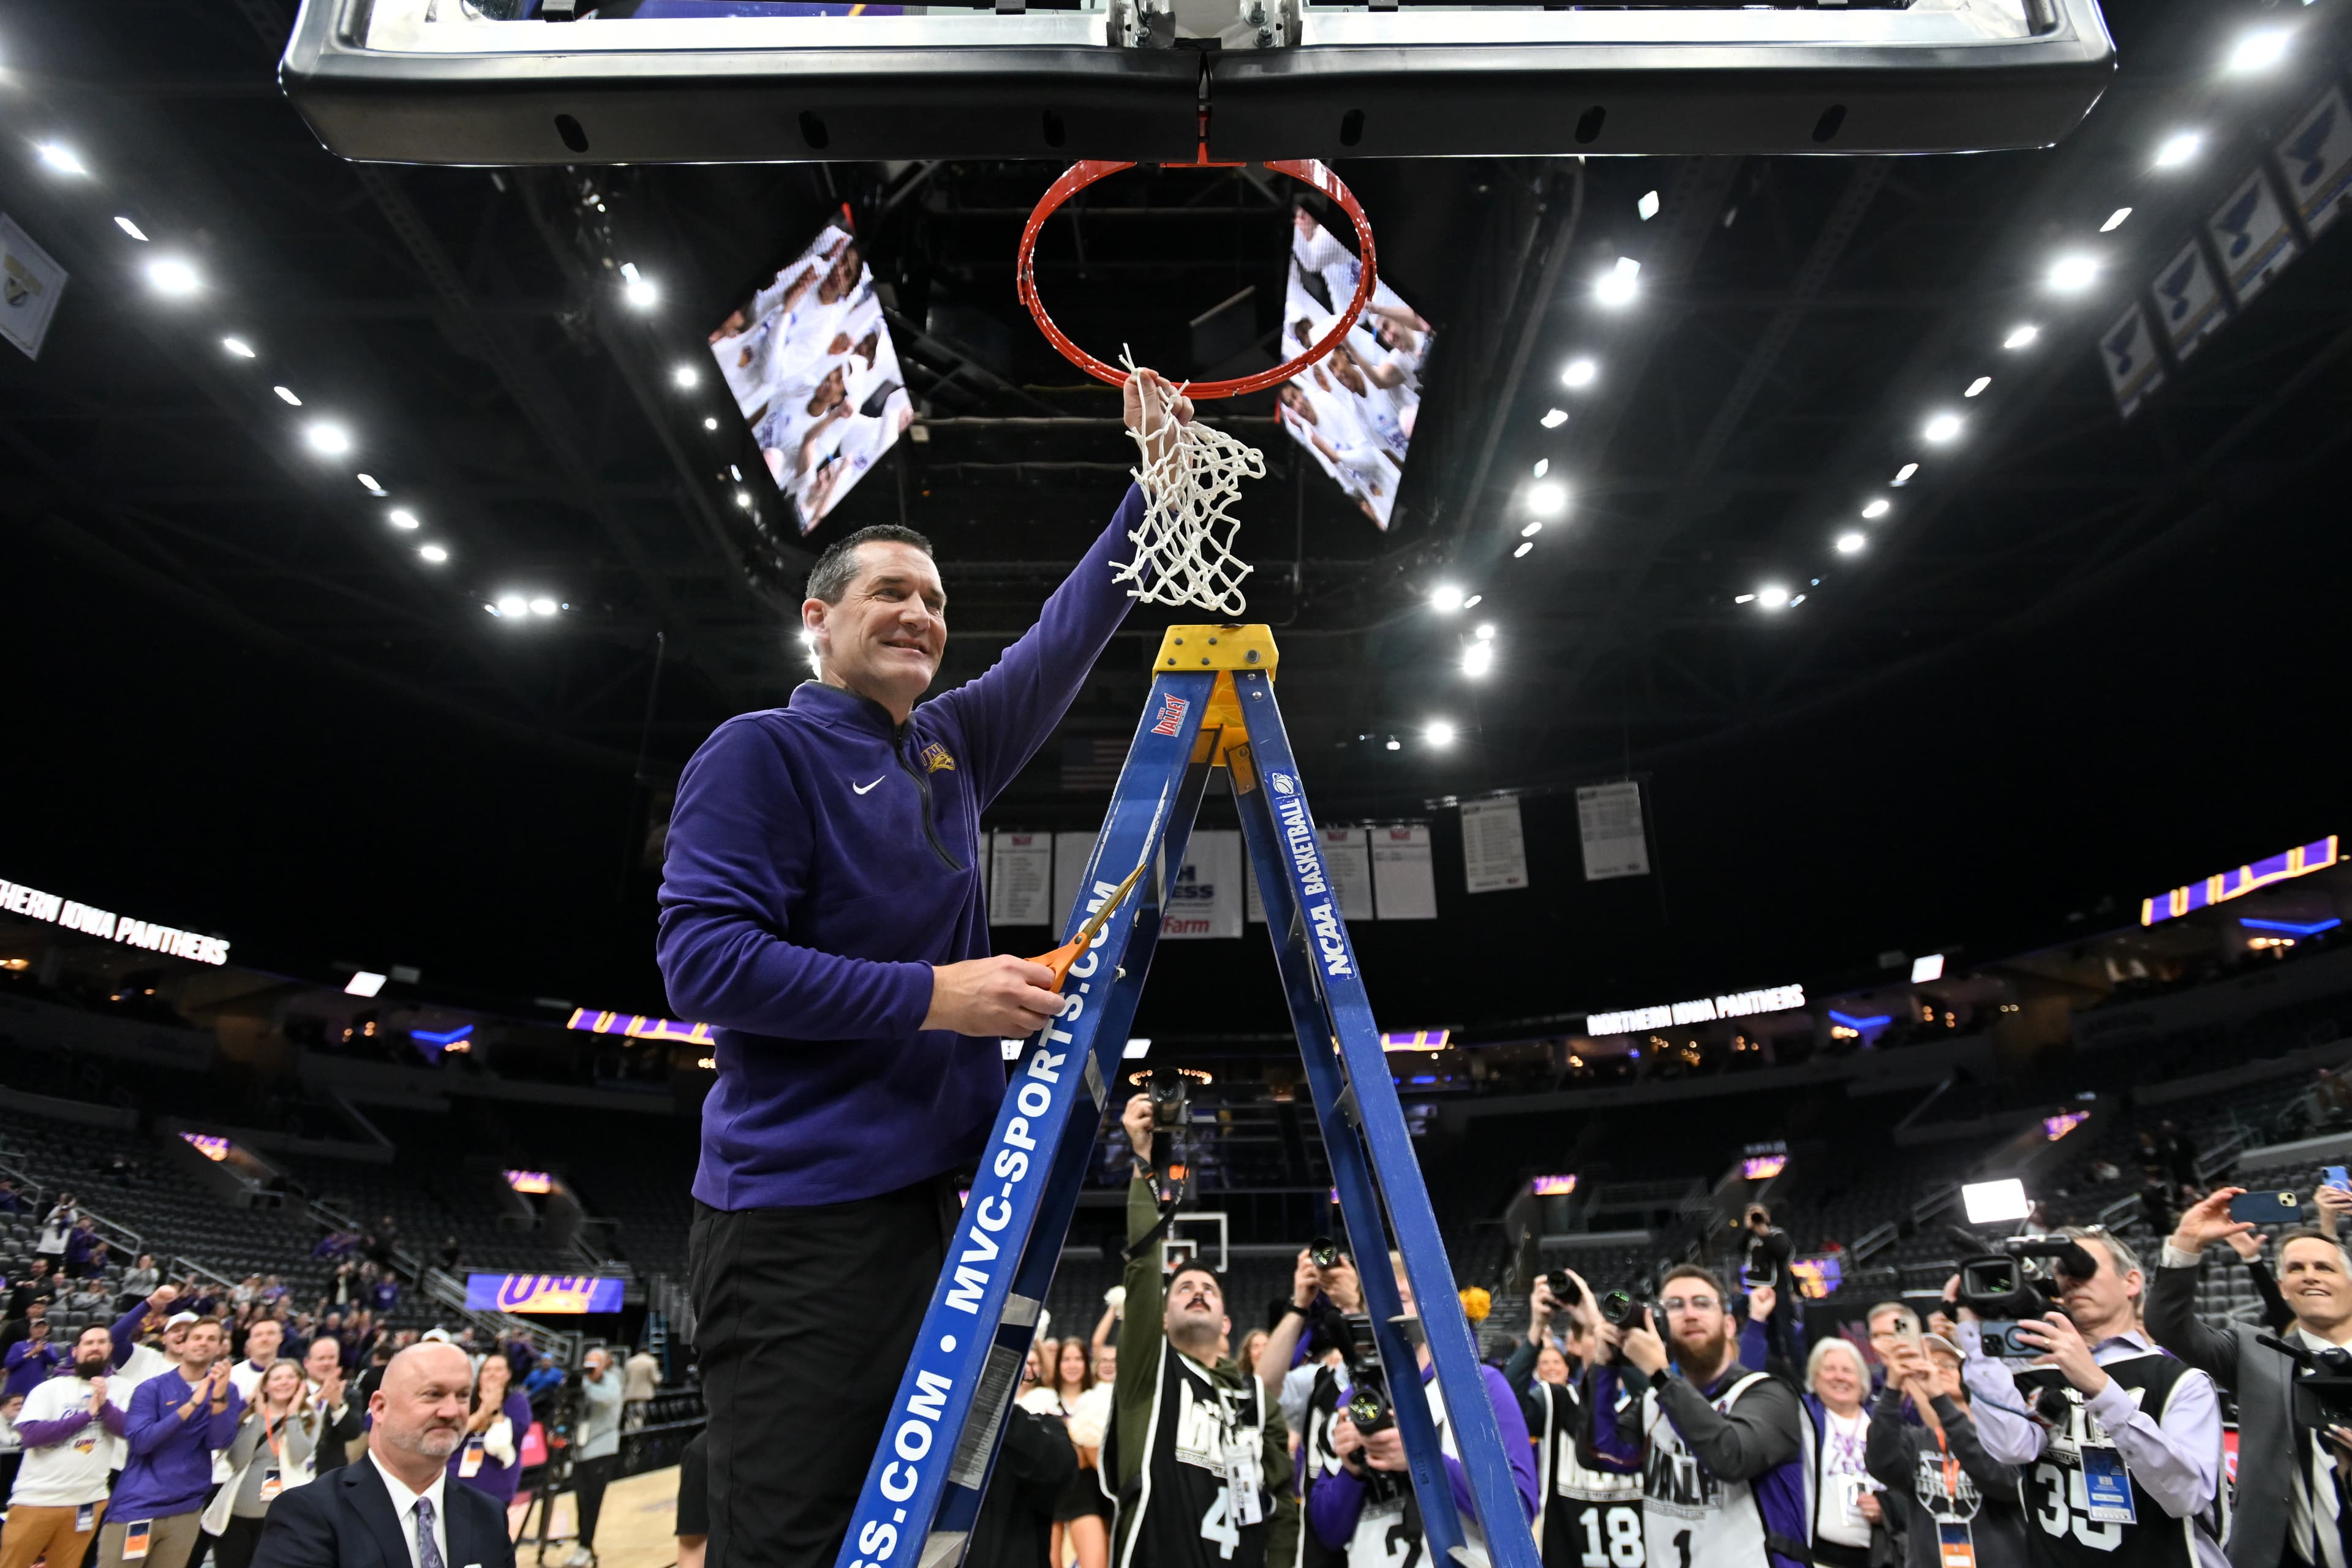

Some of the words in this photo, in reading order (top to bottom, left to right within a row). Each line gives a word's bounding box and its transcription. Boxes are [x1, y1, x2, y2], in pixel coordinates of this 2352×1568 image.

[1151, 693, 1186, 736] VALLEY
[1279, 797, 1327, 895] BASKETBALL
[59, 900, 116, 939] IOWA
[115, 917, 230, 965] PANTHERS
[1587, 1005, 1672, 1036] NORTHERN
[1671, 998, 1717, 1025] IOWA
[1716, 984, 1806, 1019] PANTHERS
[849, 1370, 953, 1568] S.COM
[1200, 1486, 1239, 1560] 4
[1579, 1506, 1646, 1568] 18
